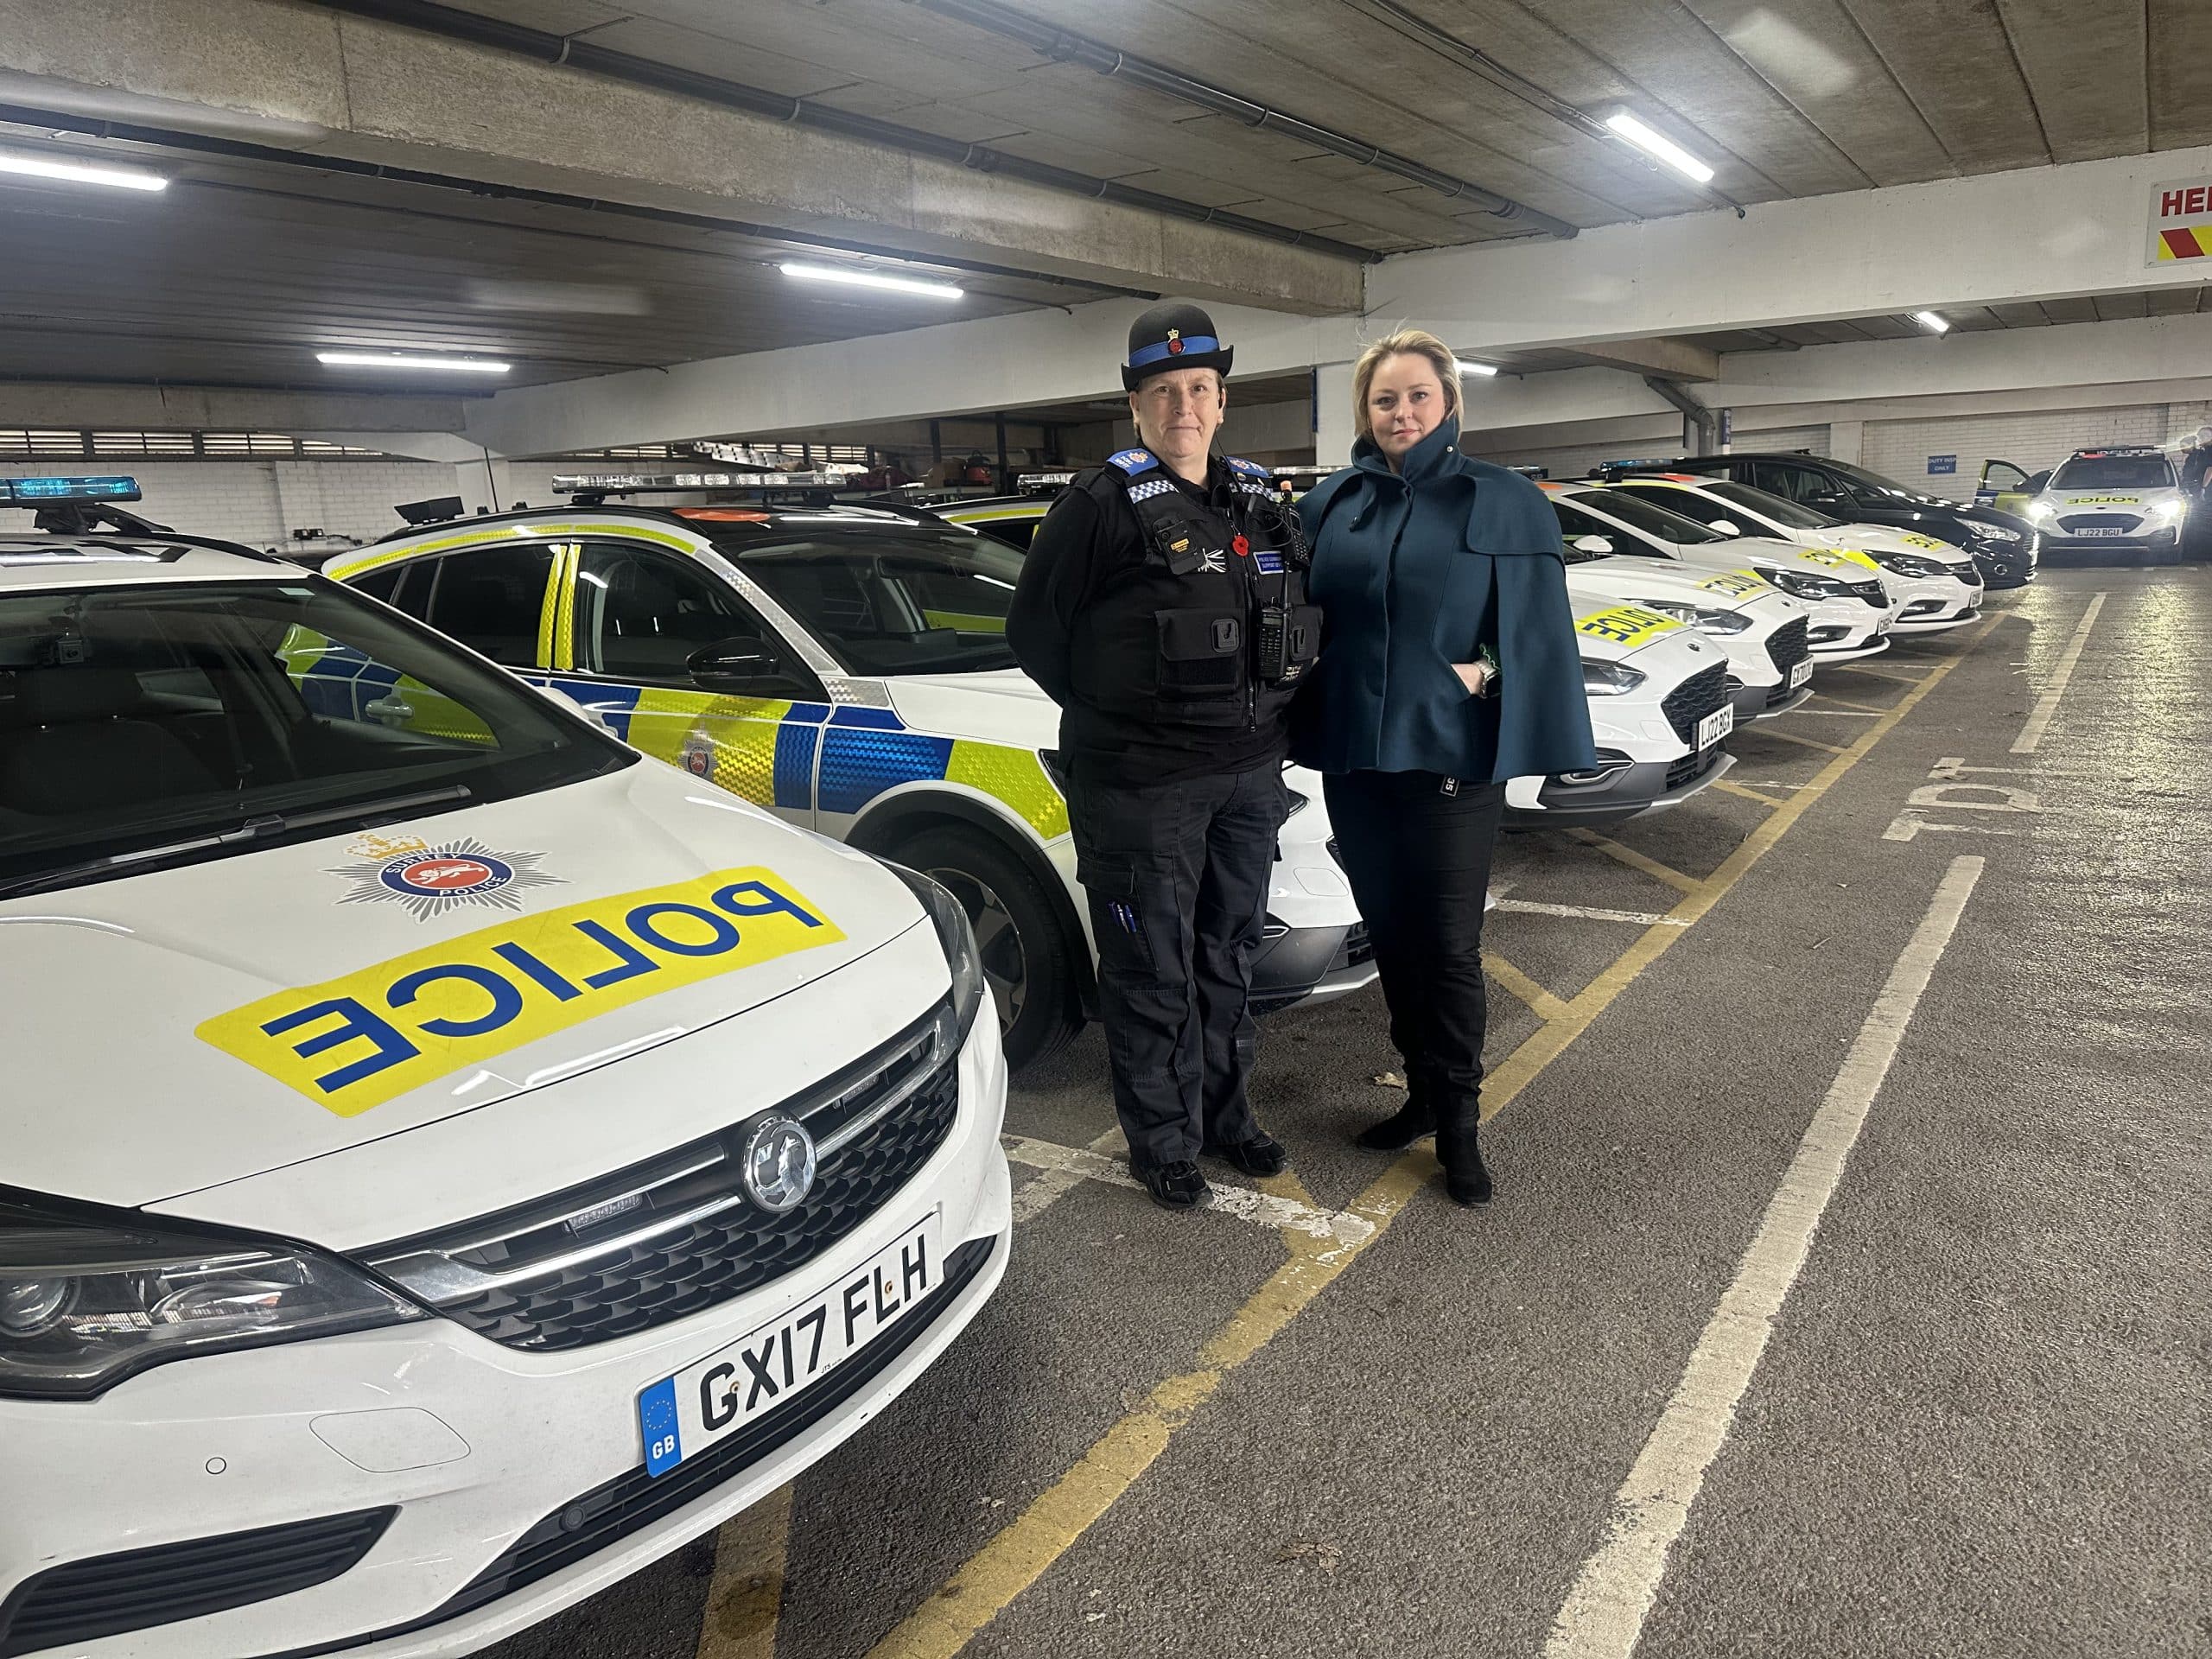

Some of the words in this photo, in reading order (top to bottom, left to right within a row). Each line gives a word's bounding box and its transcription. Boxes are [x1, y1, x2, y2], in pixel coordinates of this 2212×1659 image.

[2161, 187, 2212, 217] HE
[2101, 528, 2120, 537] BGU
[1701, 716, 1719, 747] LJ22
[1719, 708, 1732, 735] BGX
[385, 852, 462, 874] SURREY
[439, 875, 508, 898] POLICE
[700, 1303, 827, 1432] GX17
[842, 1233, 927, 1348] FLH
[652, 1434, 676, 1460] GB
